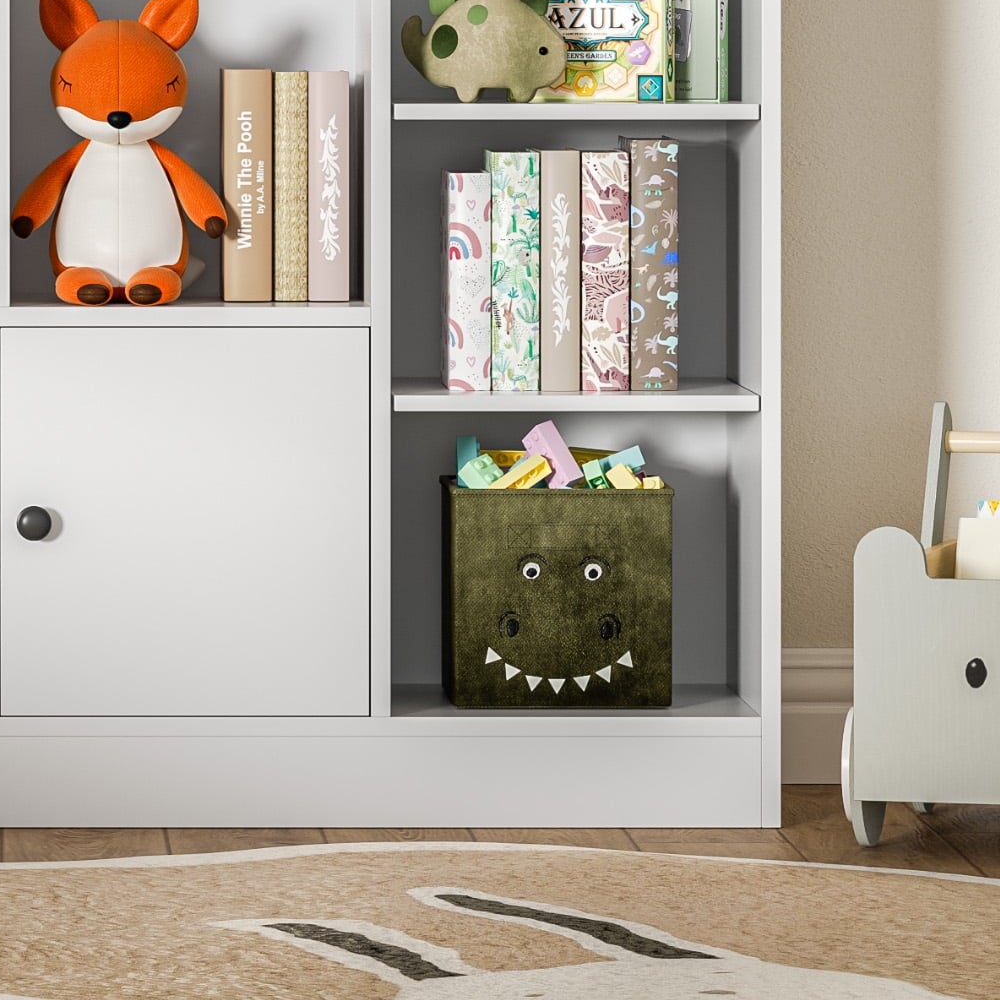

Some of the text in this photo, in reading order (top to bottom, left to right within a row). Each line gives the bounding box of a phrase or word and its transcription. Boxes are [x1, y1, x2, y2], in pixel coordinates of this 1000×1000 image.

[548, 7, 625, 30] AZUL
[567, 52, 585, 60] EEN'S
[236, 110, 253, 250] Winnie The Pooh
[256, 160, 266, 215] by A.A. Milne
